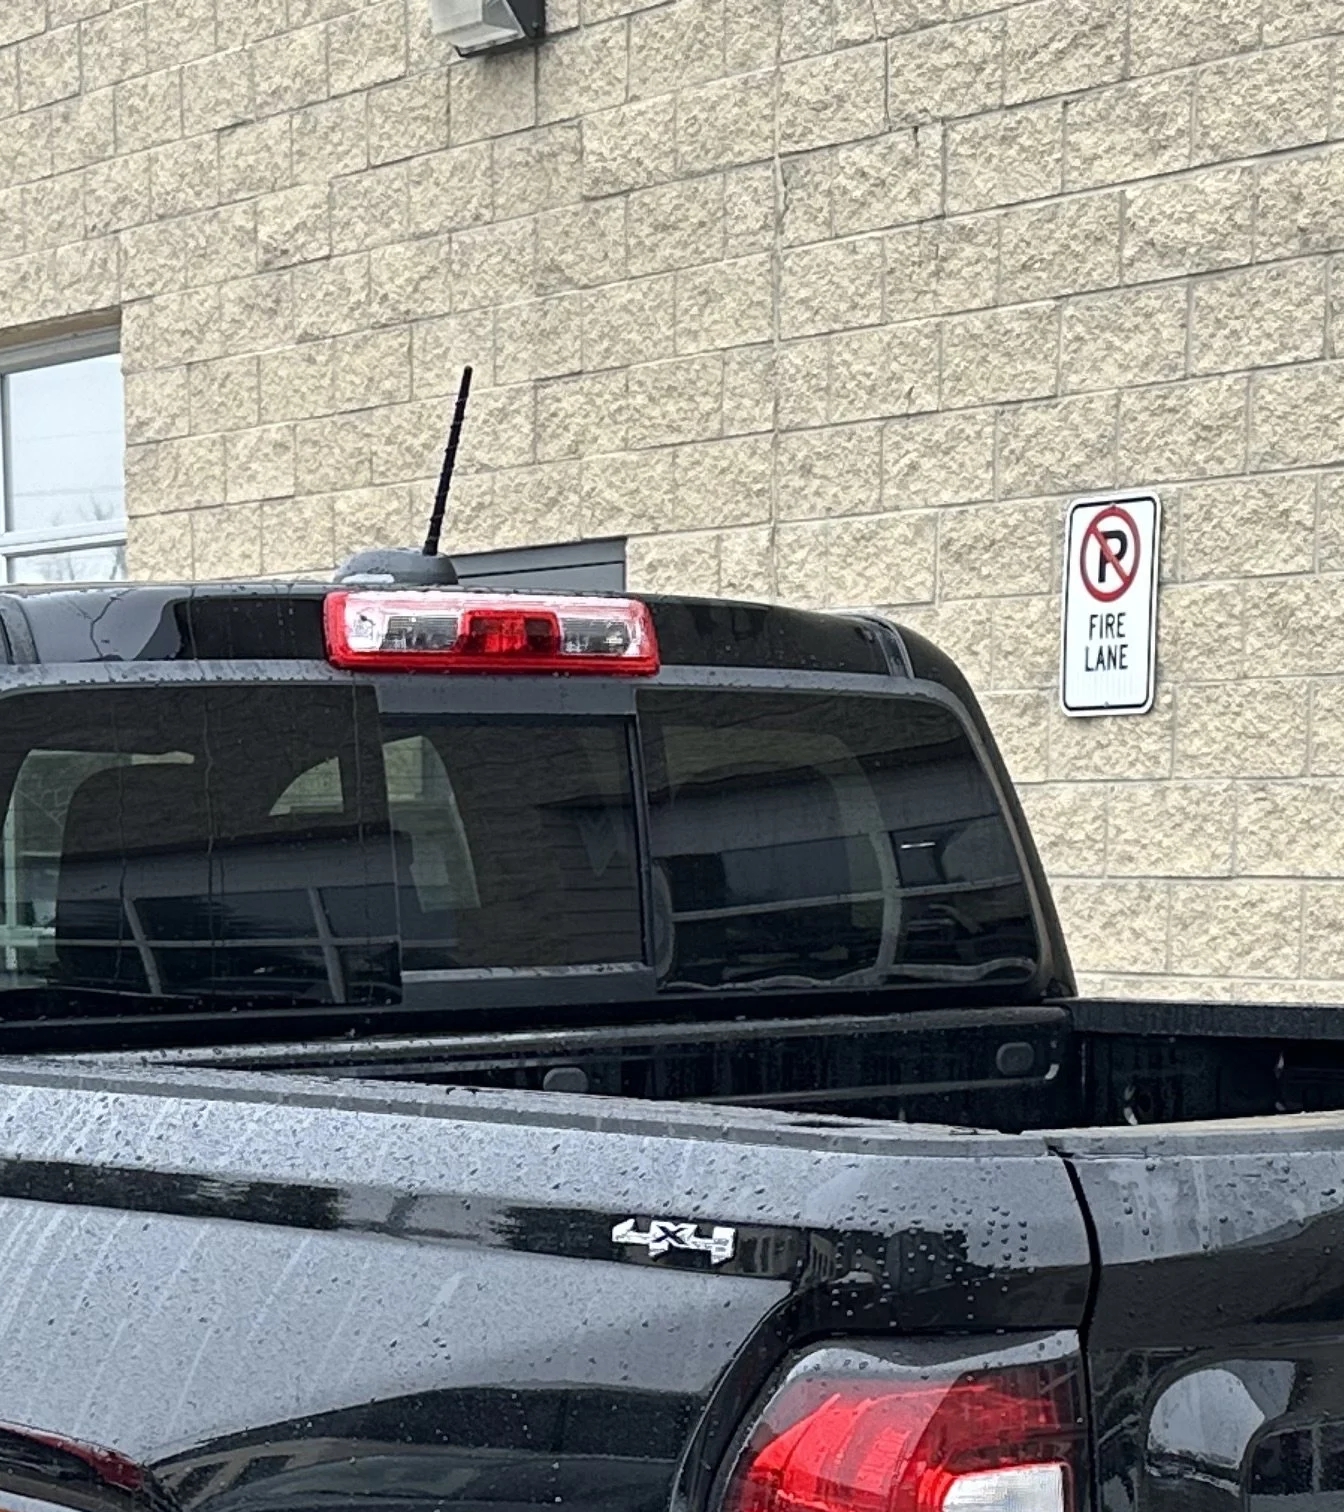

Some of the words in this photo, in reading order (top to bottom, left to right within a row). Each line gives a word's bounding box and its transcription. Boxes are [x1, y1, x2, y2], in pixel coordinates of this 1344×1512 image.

[1098, 529, 1128, 583] P
[1088, 612, 1127, 640] FIRE
[1084, 644, 1129, 672] LANE
